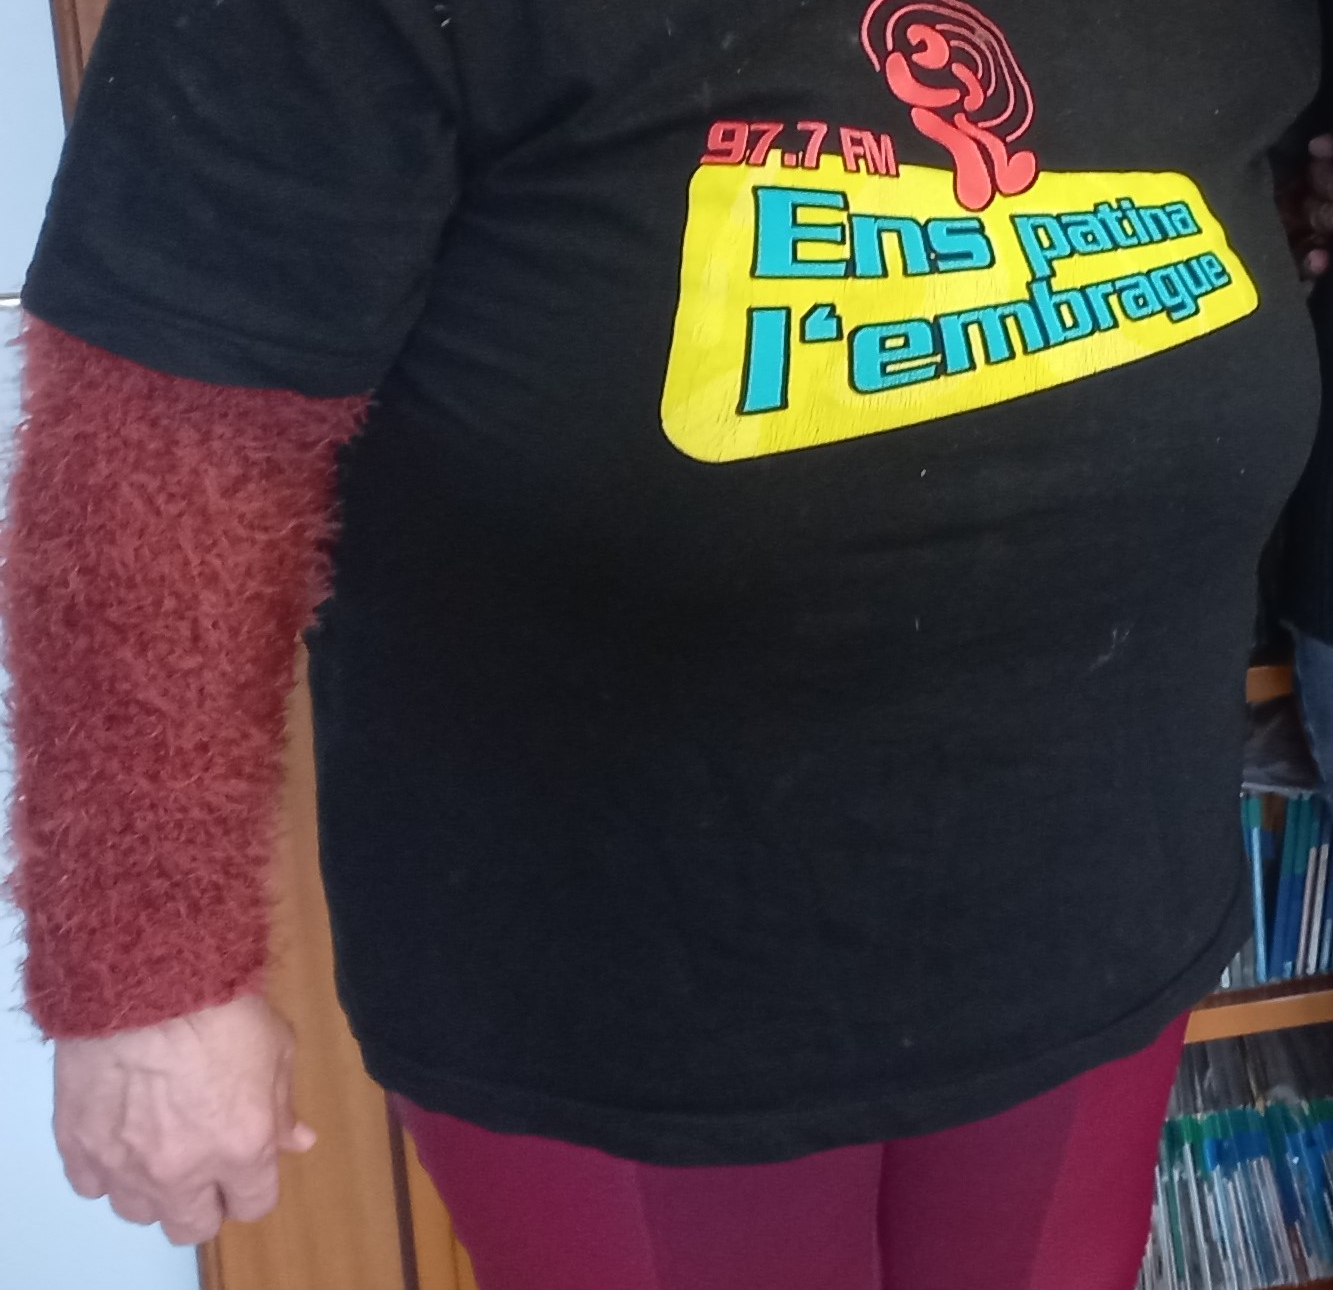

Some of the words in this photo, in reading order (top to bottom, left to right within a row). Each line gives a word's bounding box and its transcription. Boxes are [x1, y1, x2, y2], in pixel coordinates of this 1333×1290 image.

[699, 118, 828, 170] 97.7
[839, 125, 902, 179] FM
[751, 183, 996, 280] Ens
[1010, 194, 1202, 278] patina
